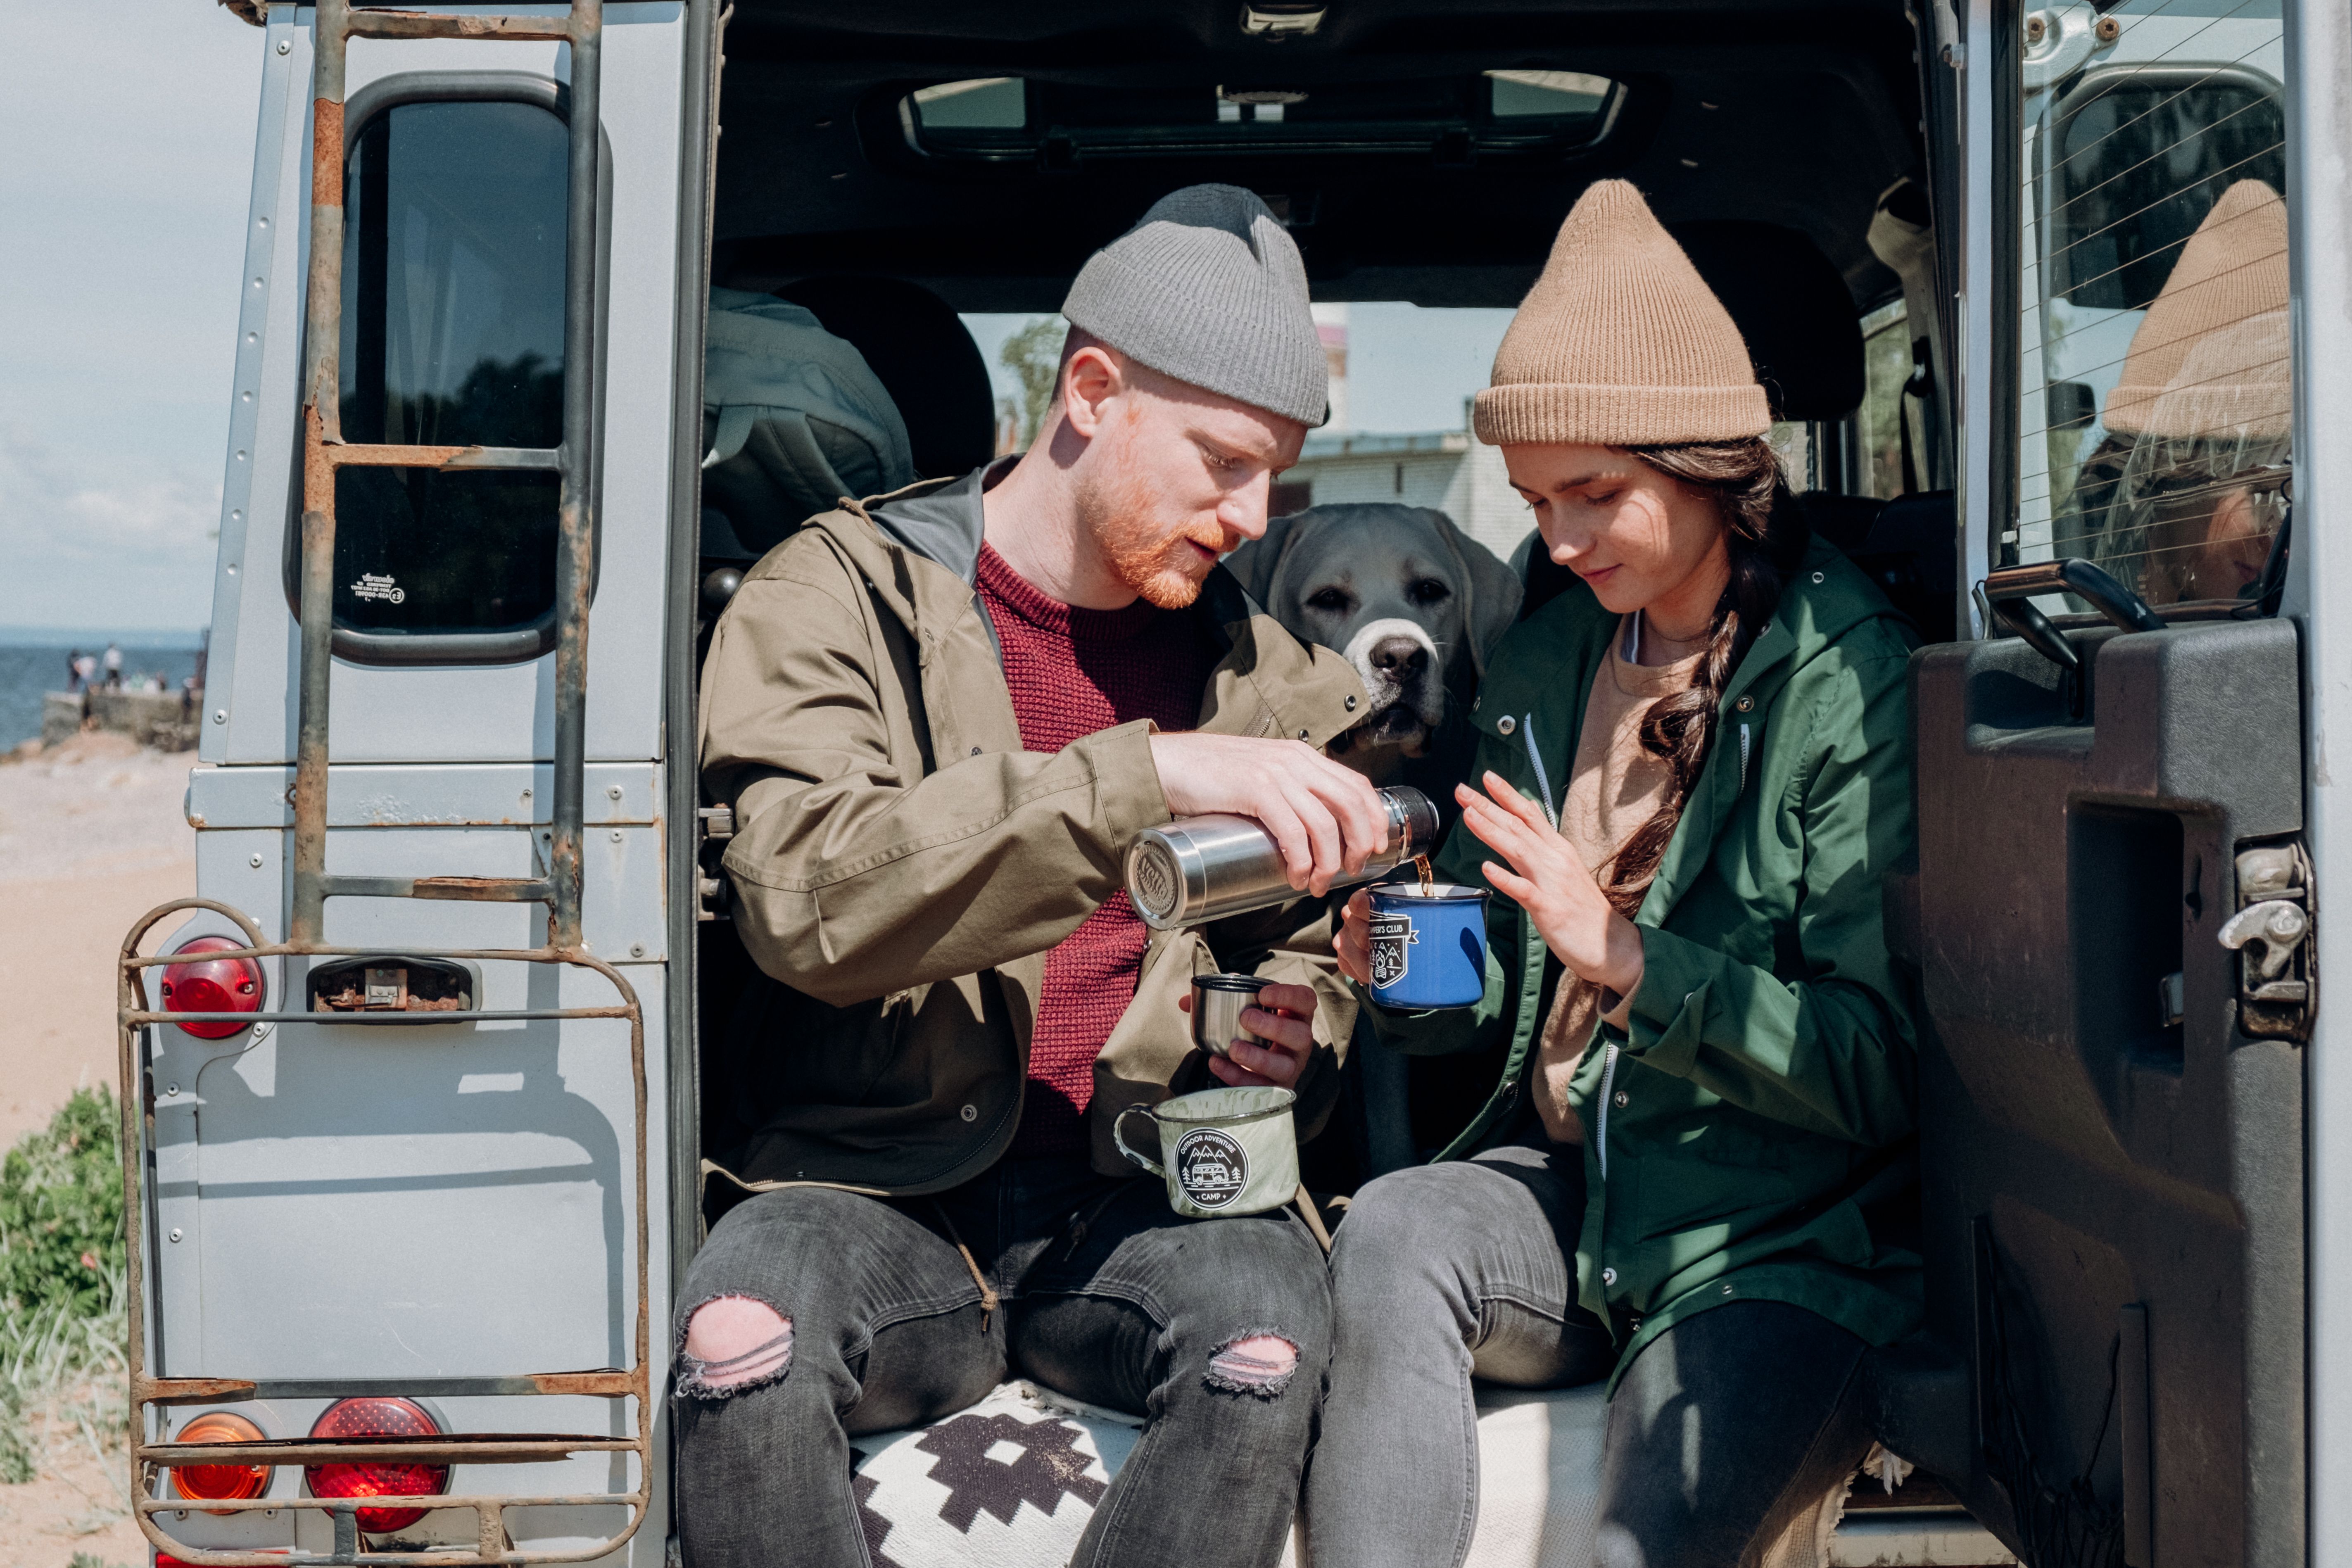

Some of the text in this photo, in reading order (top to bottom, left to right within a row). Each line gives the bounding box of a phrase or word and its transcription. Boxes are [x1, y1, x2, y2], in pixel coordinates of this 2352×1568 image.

[1386, 924, 1403, 933] CLUB
[1181, 1135, 1236, 1154] OUTDOOR ADVENTURE
